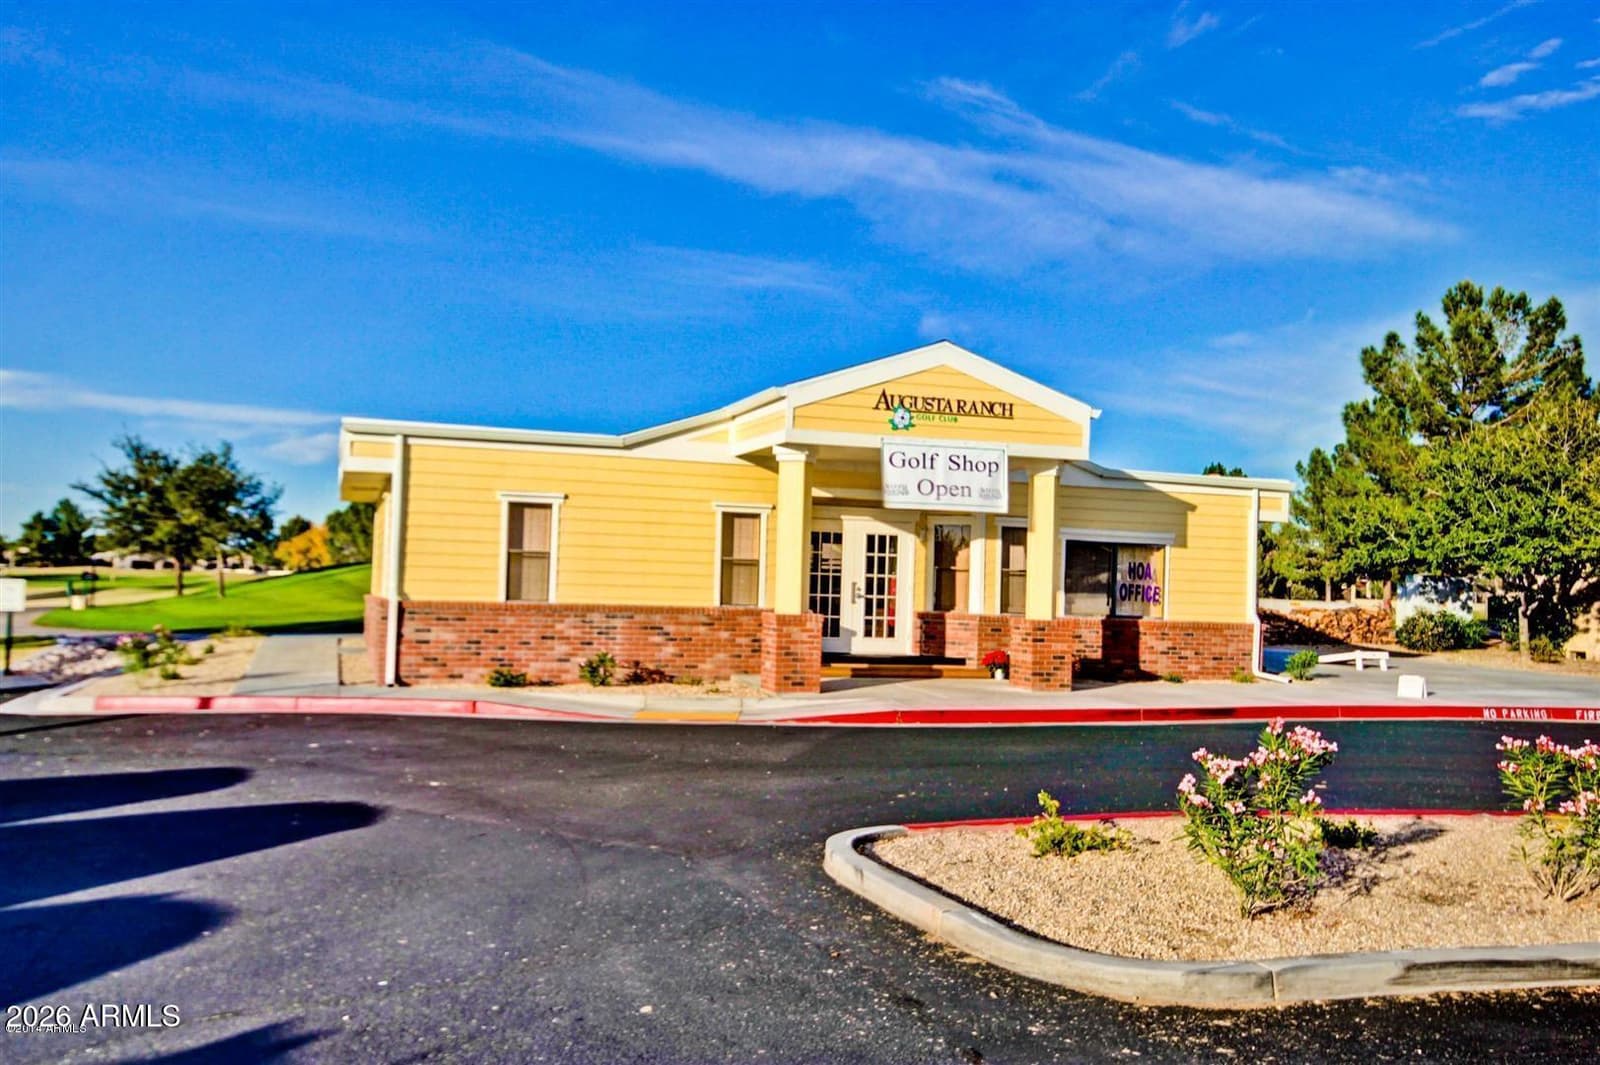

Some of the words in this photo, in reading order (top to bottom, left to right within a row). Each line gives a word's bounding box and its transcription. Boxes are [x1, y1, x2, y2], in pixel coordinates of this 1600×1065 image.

[872, 388, 953, 413] AUGUSTA
[956, 399, 1014, 417] RANCH
[916, 414, 935, 422] GOLF
[938, 415, 958, 423] CLUB
[889, 451, 939, 470] Golf
[948, 454, 999, 477] Shop
[917, 478, 972, 501] Open
[1128, 562, 1152, 580] HOA
[1120, 583, 1160, 603] OFFICE
[1483, 707, 1497, 721] NO
[1502, 708, 1548, 720] PARKING
